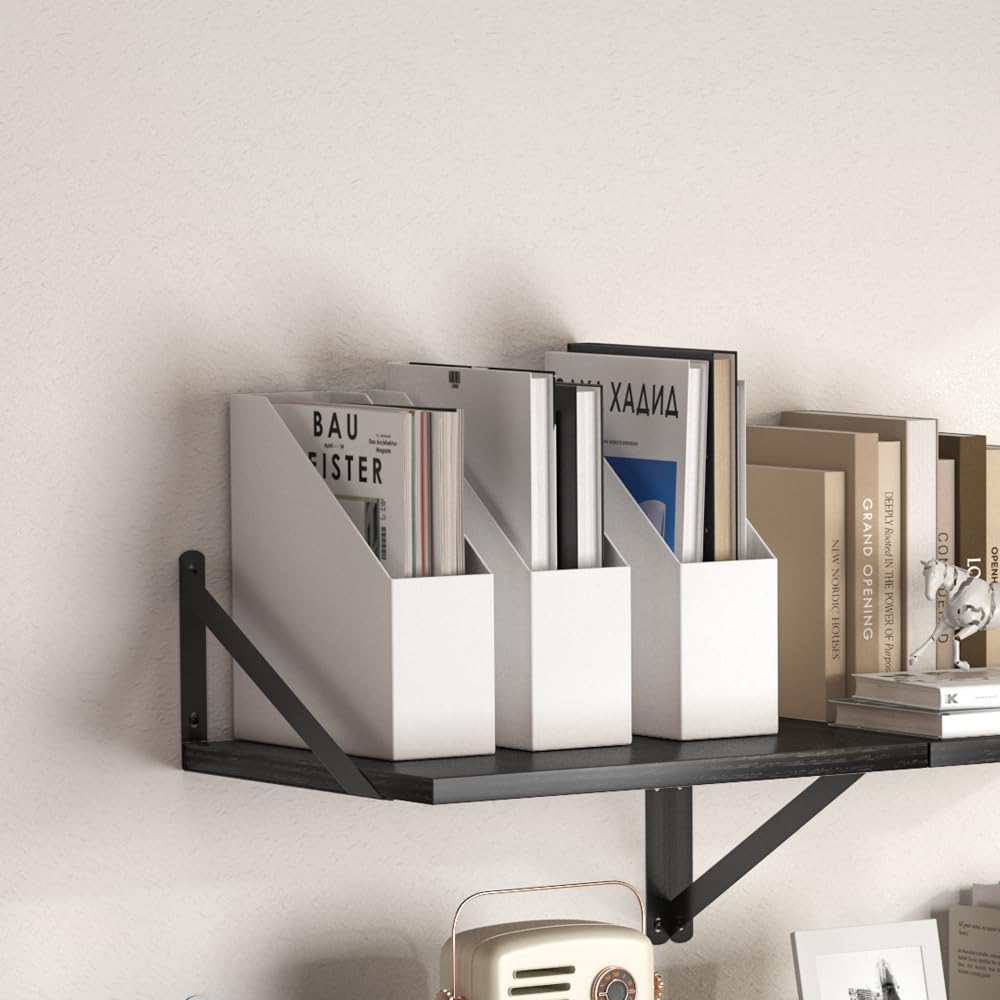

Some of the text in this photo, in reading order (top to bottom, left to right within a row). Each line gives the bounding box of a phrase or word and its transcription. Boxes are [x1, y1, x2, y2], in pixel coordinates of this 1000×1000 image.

[608, 381, 679, 419] ХАДИД
[312, 410, 358, 441] BAU
[884, 491, 894, 525] DEEPLY
[884, 527, 894, 557] Rooted
[862, 498, 873, 641] GRAND OPENING
[884, 558, 894, 568] IN
[884, 570, 894, 590] THE
[990, 546, 999, 584] OPENH
[831, 539, 840, 660] NEW NORDIC HOUSES
[884, 592, 894, 627] POWER
[884, 628, 894, 642] OF
